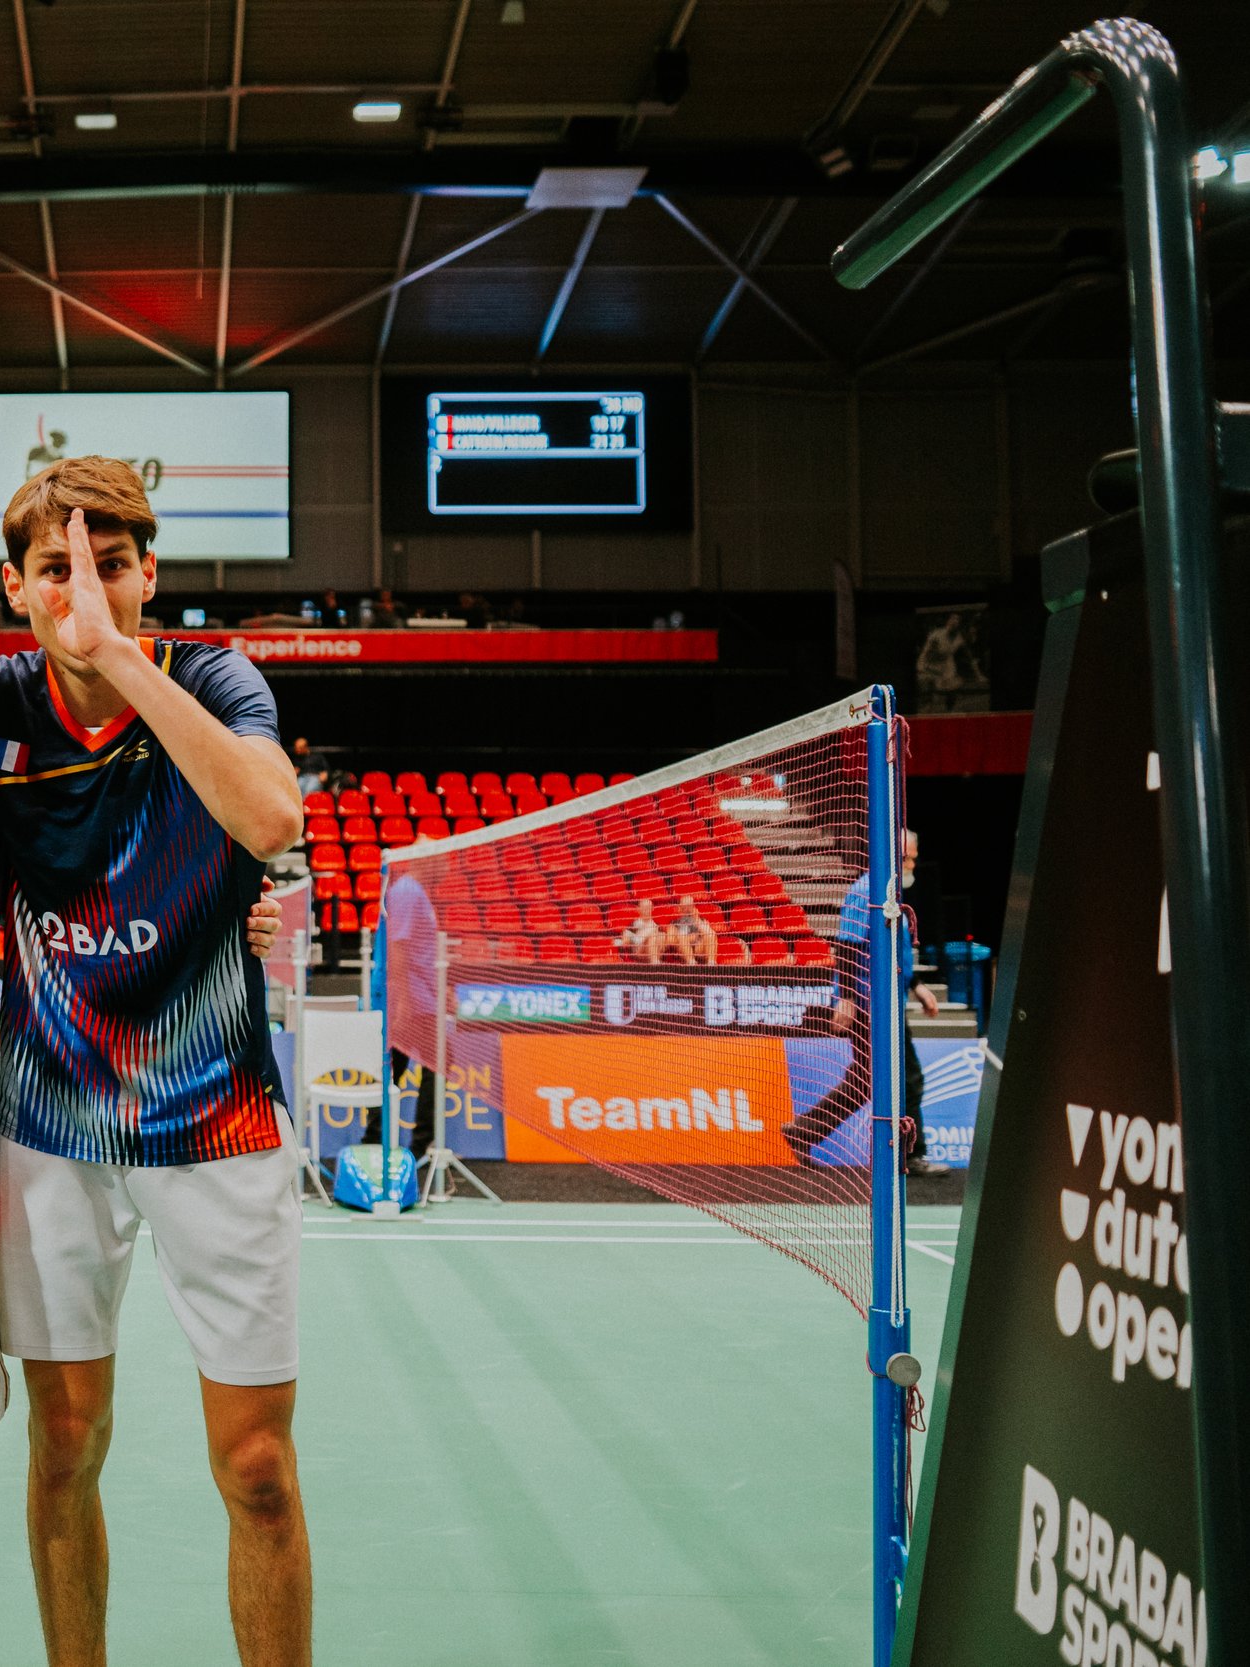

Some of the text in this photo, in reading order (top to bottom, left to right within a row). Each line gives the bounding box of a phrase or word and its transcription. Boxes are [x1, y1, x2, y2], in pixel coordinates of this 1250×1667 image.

[230, 635, 362, 660] Experience
[508, 991, 581, 1017] YONEX
[536, 1087, 763, 1132] TeamNL
